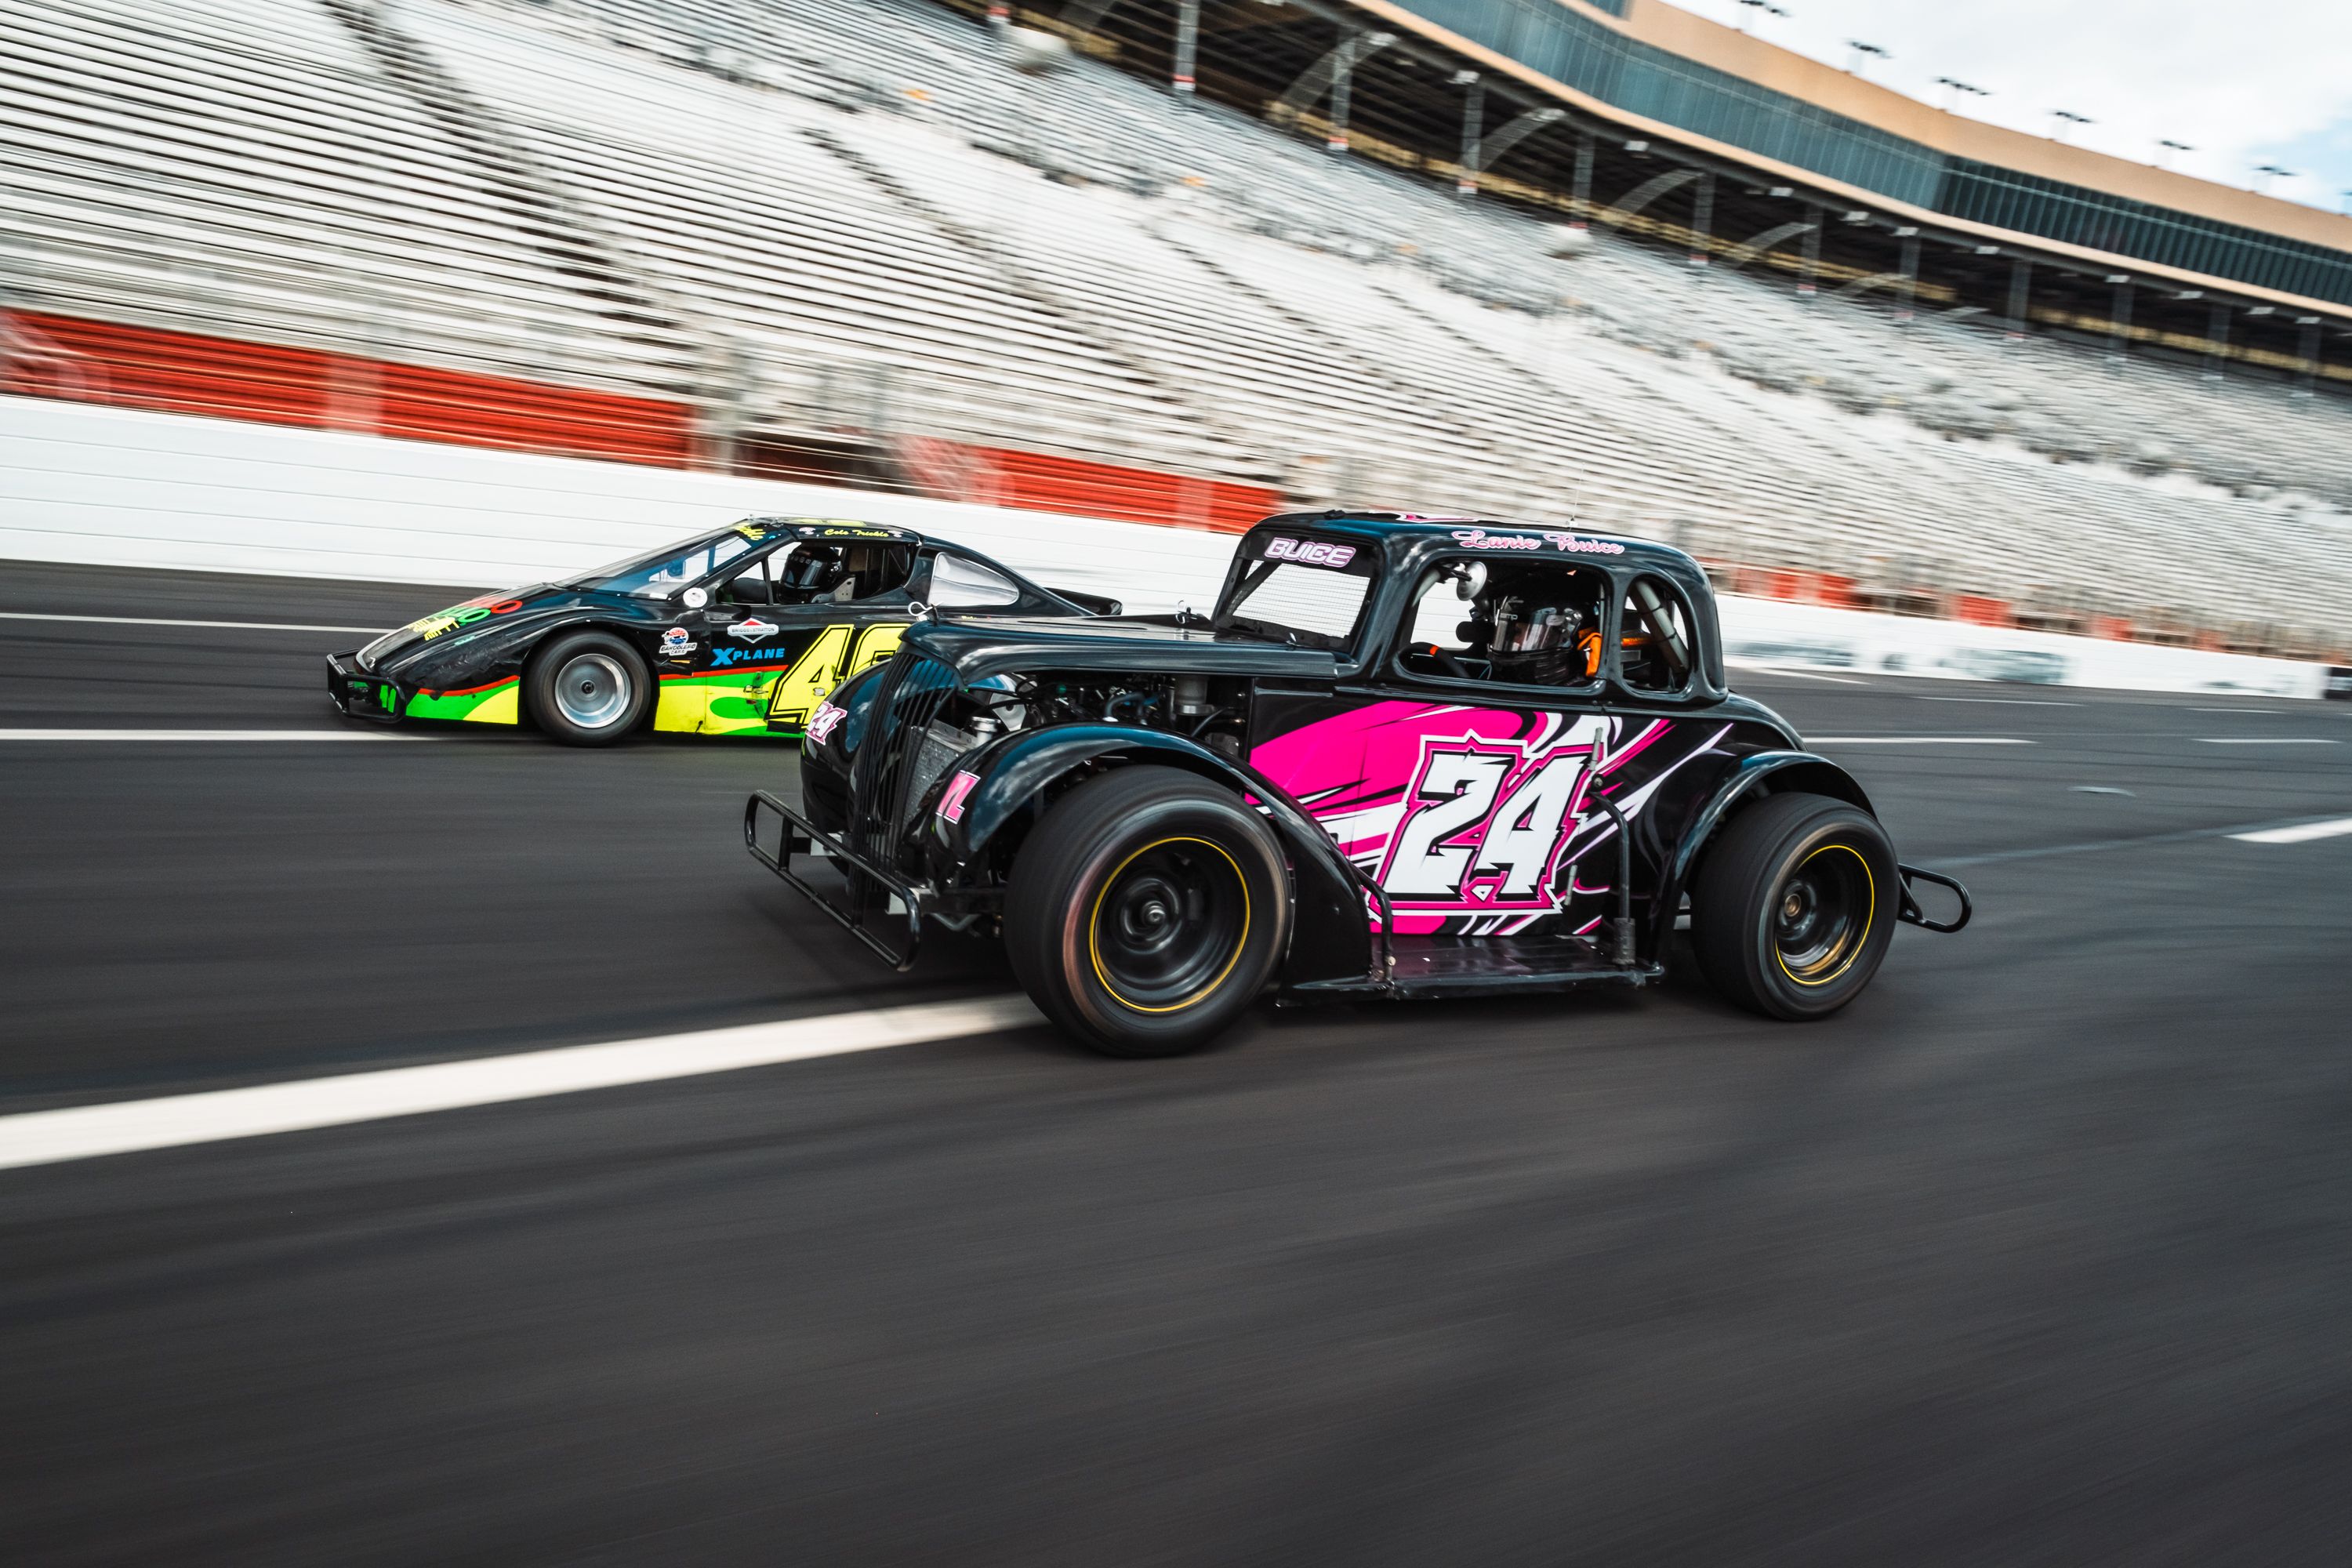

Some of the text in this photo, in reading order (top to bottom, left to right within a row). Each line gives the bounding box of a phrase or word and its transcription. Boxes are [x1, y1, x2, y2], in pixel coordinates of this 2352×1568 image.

[851, 529, 889, 538] Trickle
[1451, 530, 1625, 554] Lanie Buice
[1265, 538, 1356, 568] BUICE
[710, 648, 785, 666] XPLANE
[805, 702, 845, 742] 24
[1383, 751, 1591, 900] 24
